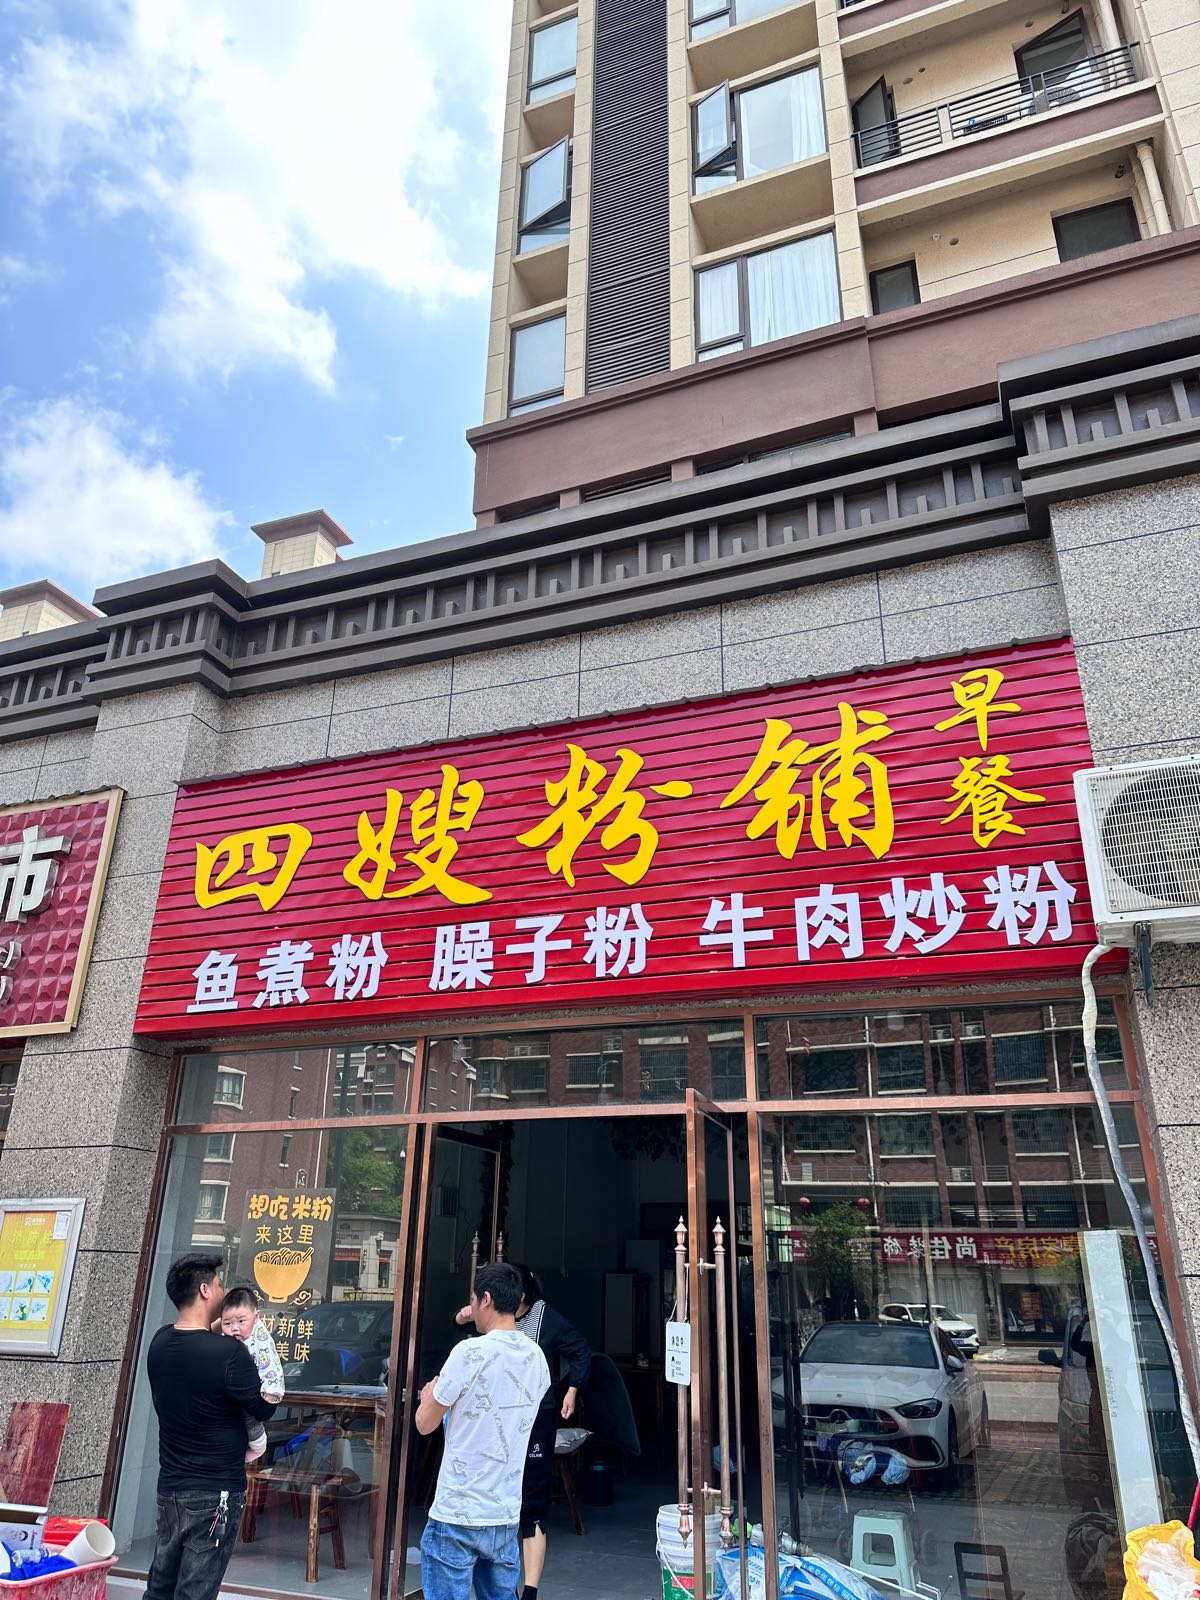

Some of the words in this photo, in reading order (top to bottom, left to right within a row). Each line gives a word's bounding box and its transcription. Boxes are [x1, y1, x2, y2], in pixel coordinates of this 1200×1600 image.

[934, 667, 1047, 849] 早餐
[186, 932, 389, 1014] 鱼煮粉
[428, 902, 654, 991] 臊子粉
[700, 860, 1078, 968] 牛肉炒粉
[247, 1194, 334, 1222] 想吃米粉
[254, 1224, 315, 1246] 来这里
